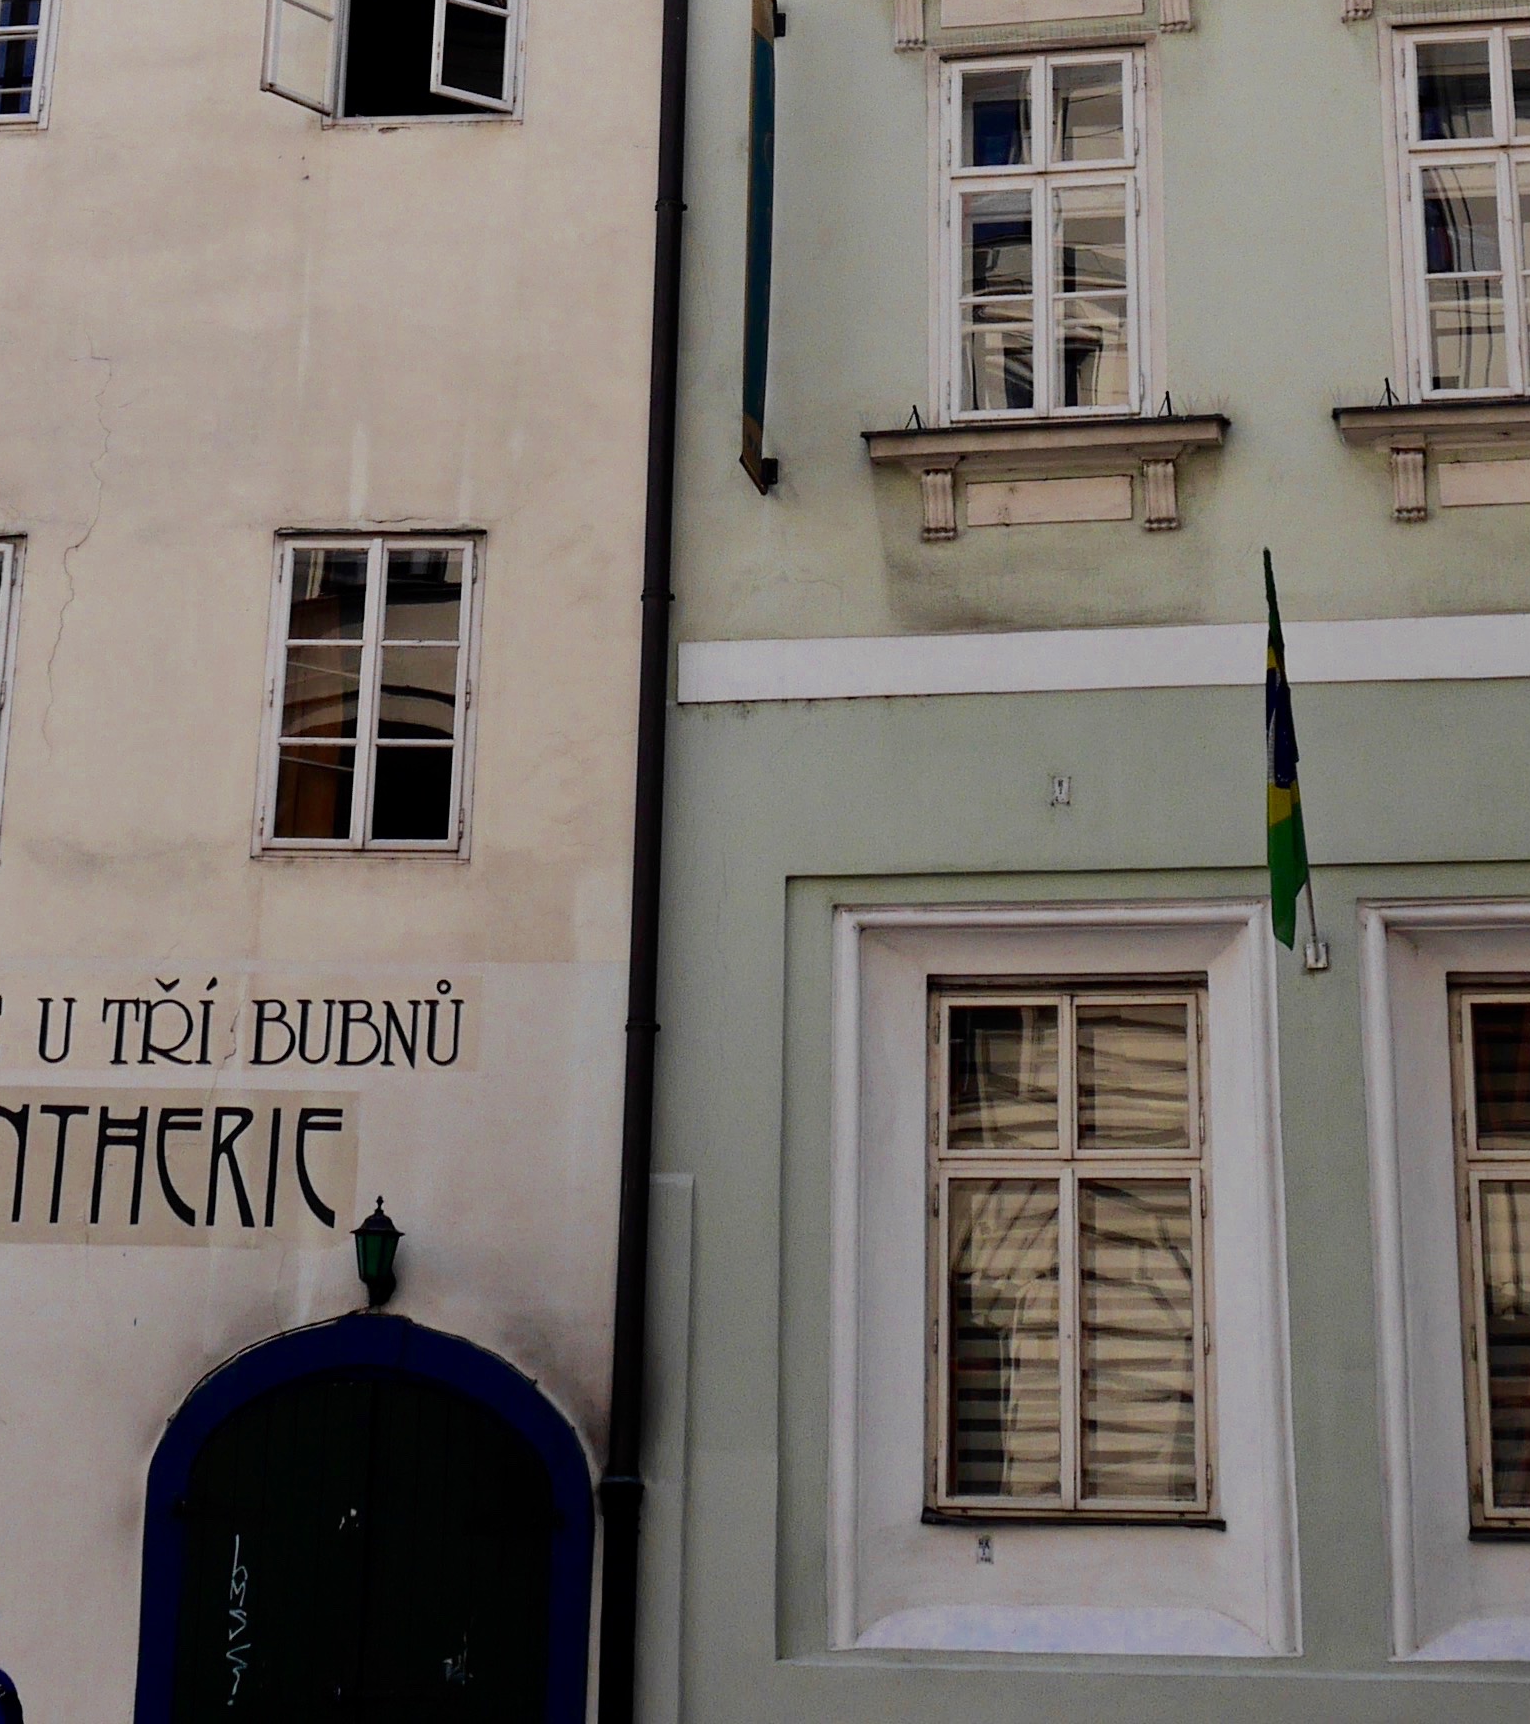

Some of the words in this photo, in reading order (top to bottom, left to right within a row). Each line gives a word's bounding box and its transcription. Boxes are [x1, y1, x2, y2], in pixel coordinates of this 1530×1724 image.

[36, 996, 77, 1065] U
[101, 976, 220, 1067] TŘÍ
[248, 978, 465, 1067] BUBNŮ
